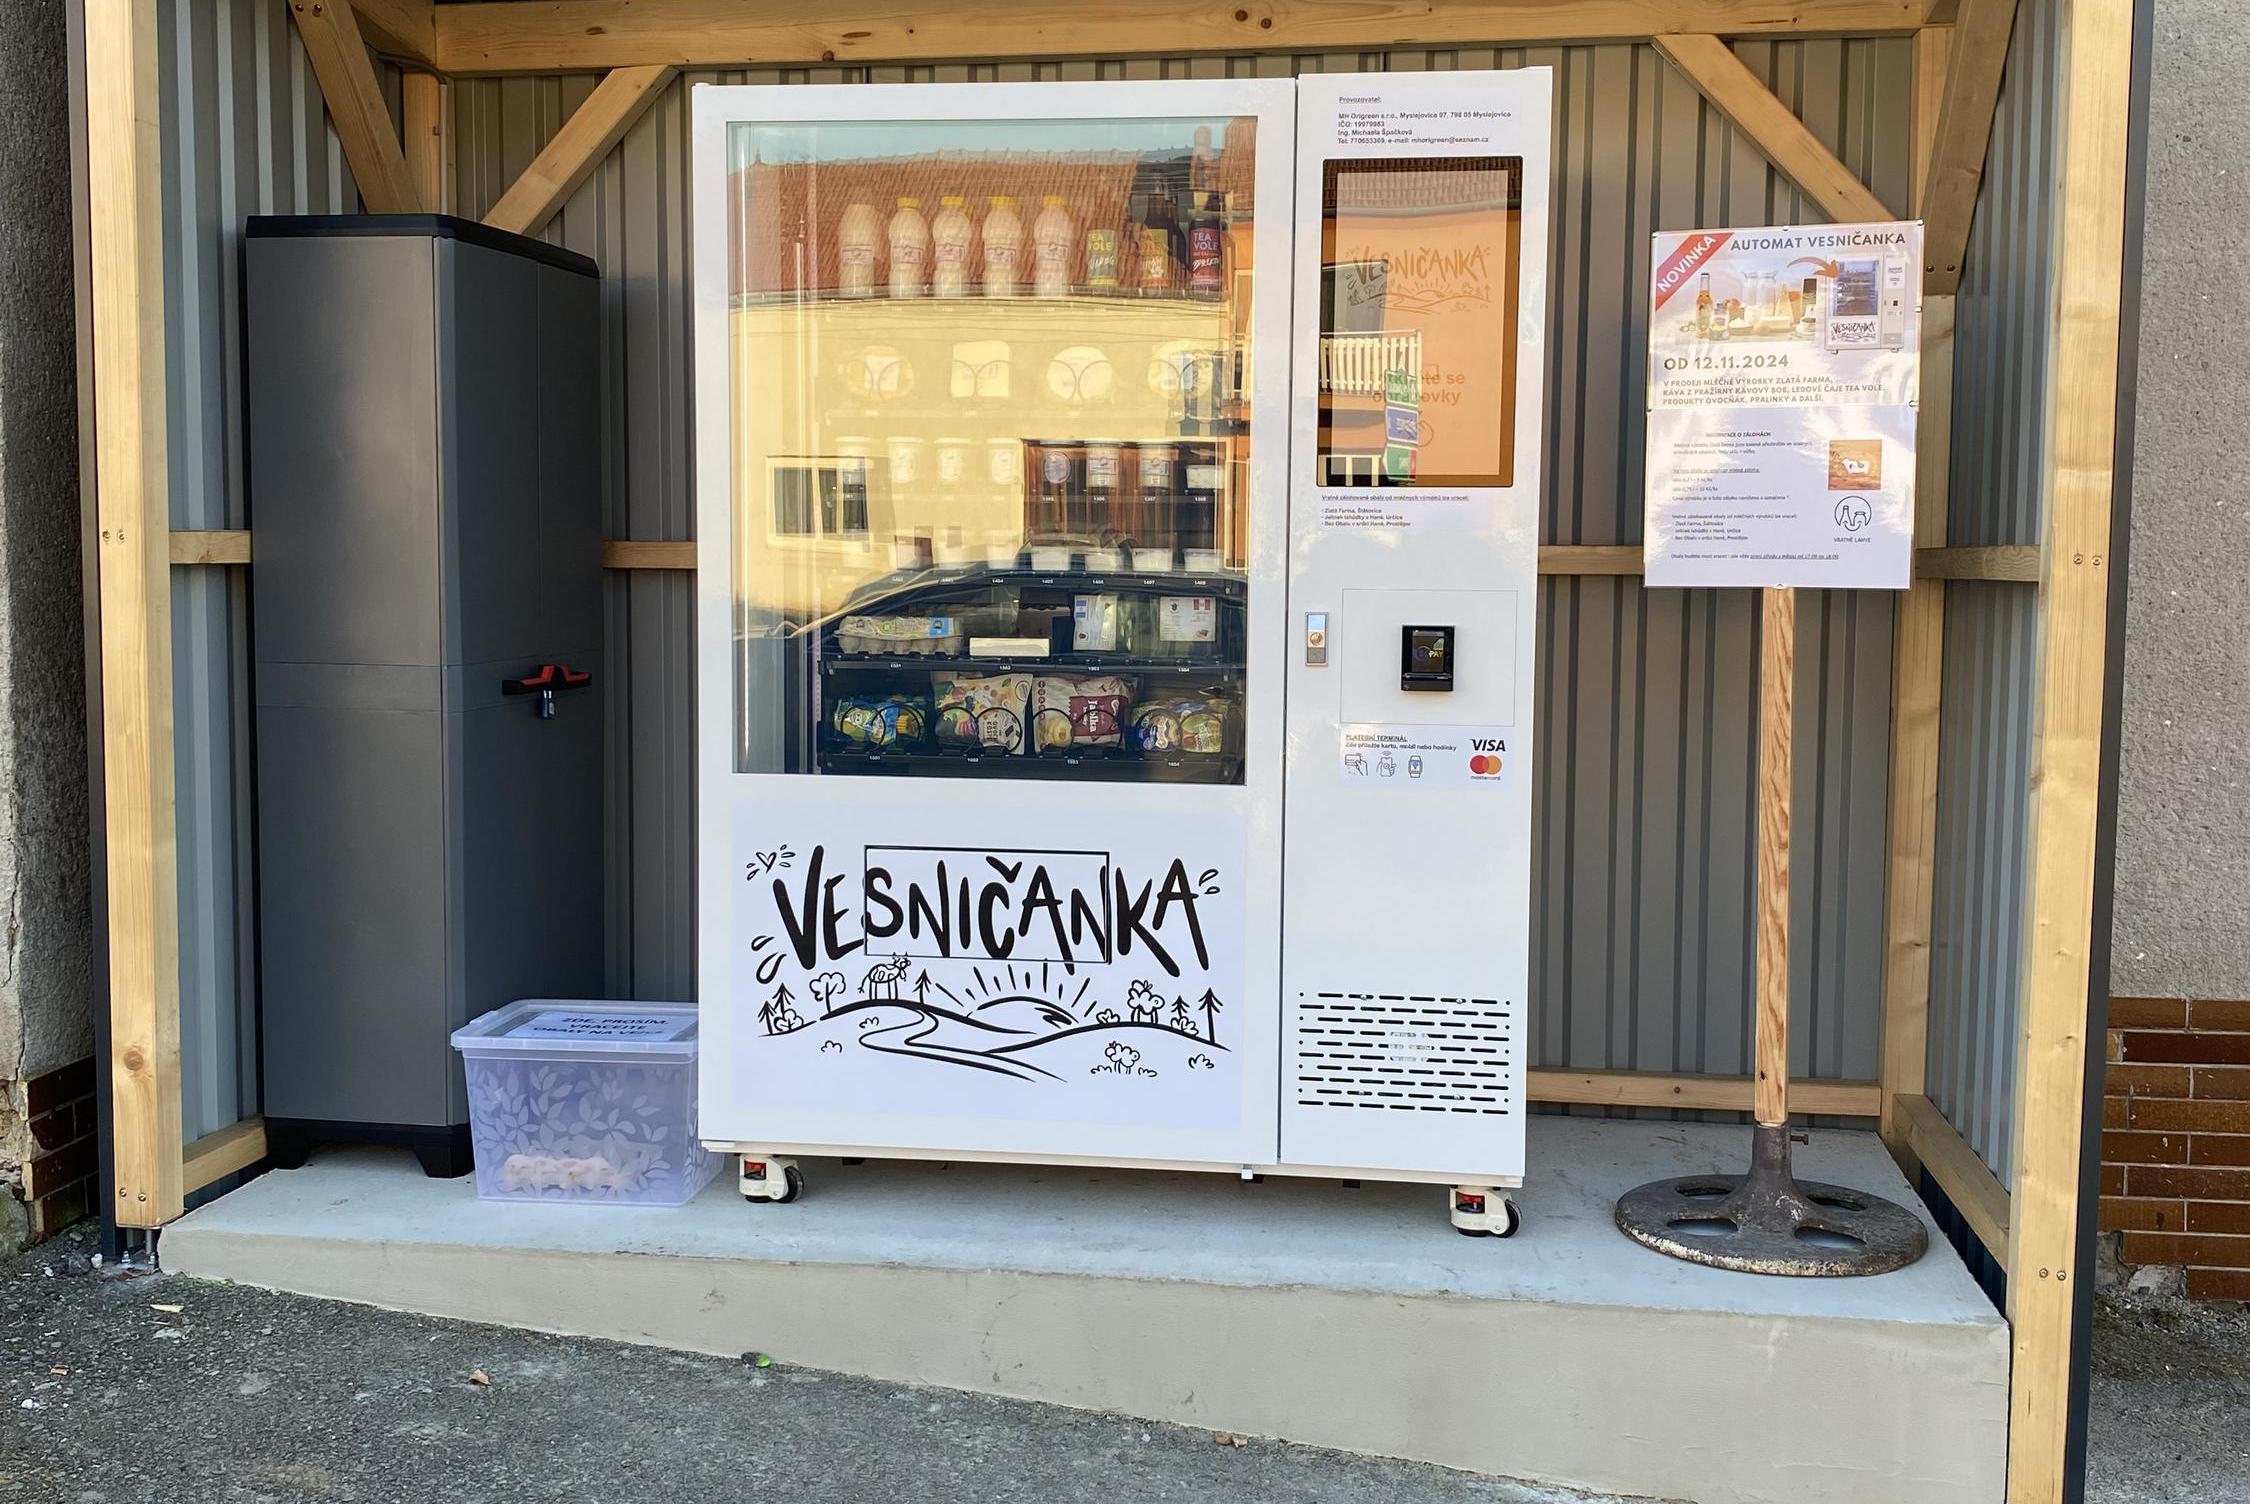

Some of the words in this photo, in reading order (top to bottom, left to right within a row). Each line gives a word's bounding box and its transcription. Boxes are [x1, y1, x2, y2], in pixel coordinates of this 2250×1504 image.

[1193, 232, 1212, 241] TEA
[1730, 237, 1802, 251] AUTOMAT
[1808, 231, 1905, 248] VESNIČANKA
[1193, 241, 1218, 250] VOLE
[1354, 245, 1489, 285] VESNIČANKA
[1657, 235, 1716, 292] NOVINKA
[1664, 357, 1689, 371] OD
[1694, 354, 1789, 370] 12.11.2024
[1447, 373, 1465, 385] se
[1703, 377, 1733, 386] MLÉČNÉ
[1735, 376, 1773, 385] VÝROBKY
[1776, 375, 1801, 384] ZLATÁ
[1694, 386, 1733, 396] PRAŽÍRNY
[1735, 385, 1769, 395] KÁVOVÝ
[1792, 385, 1822, 393] LEDOVÉ
[1824, 383, 1843, 392] ČAJE
[1845, 384, 1859, 392] TEA
[1088, 700, 1099, 732] Jablka
[1469, 738, 1506, 752] VISA
[773, 845, 1209, 977] VESNIČANKA
